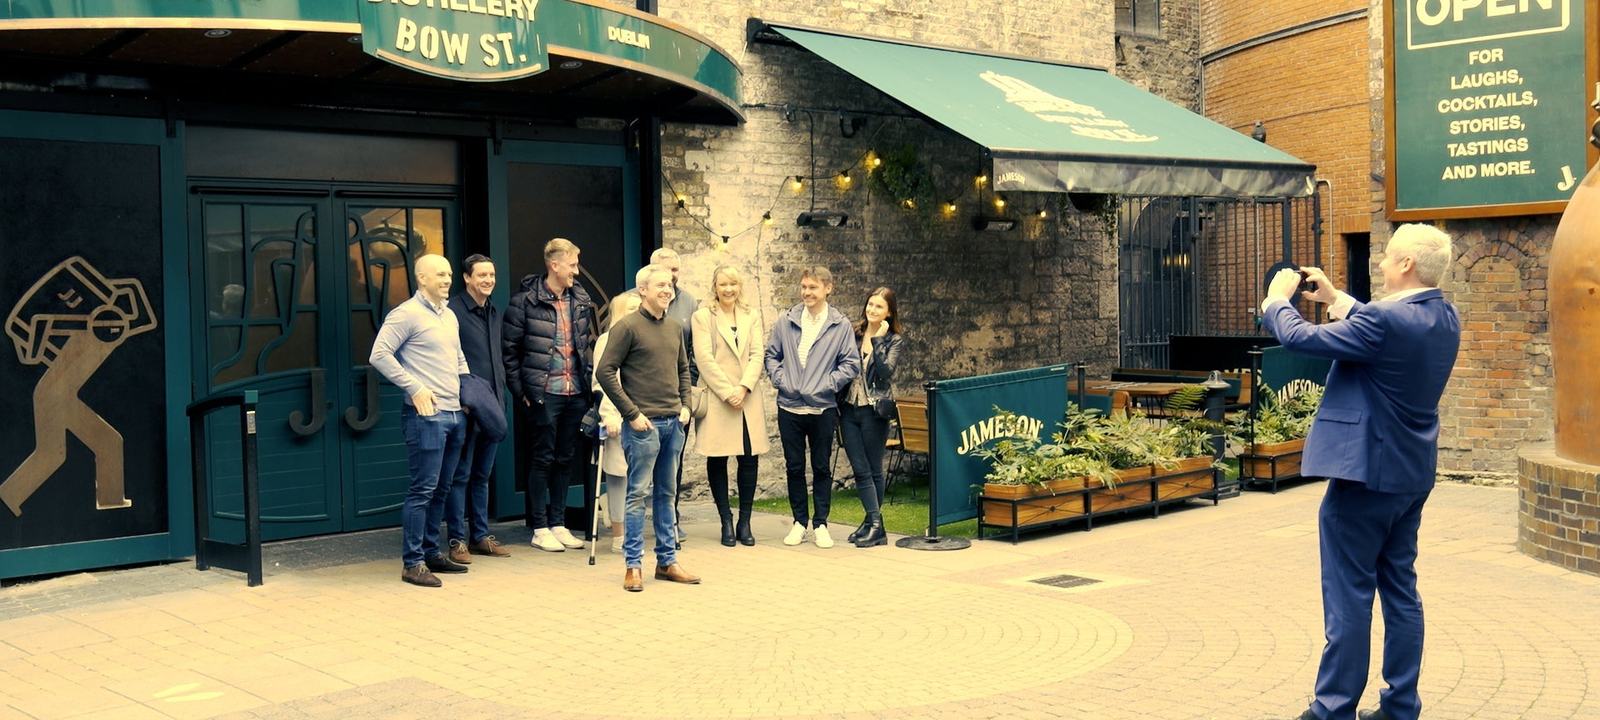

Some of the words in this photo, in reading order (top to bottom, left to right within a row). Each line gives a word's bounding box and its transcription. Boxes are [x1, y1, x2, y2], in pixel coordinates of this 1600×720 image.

[1416, 0, 1552, 26] OPE
[395, 17, 469, 65] BOW
[479, 32, 527, 67] ST.
[607, 25, 650, 50] DUBLIN
[1469, 48, 1504, 65] FOR
[1451, 69, 1524, 90] LAUGHS,
[1437, 91, 1538, 114] COCKTAILS,
[1449, 115, 1526, 135] STORIES,
[1447, 138, 1529, 157] TASTINGS
[1441, 166, 1477, 180] AND
[1480, 160, 1536, 178] MORE.
[957, 414, 1044, 455] JAMESON
